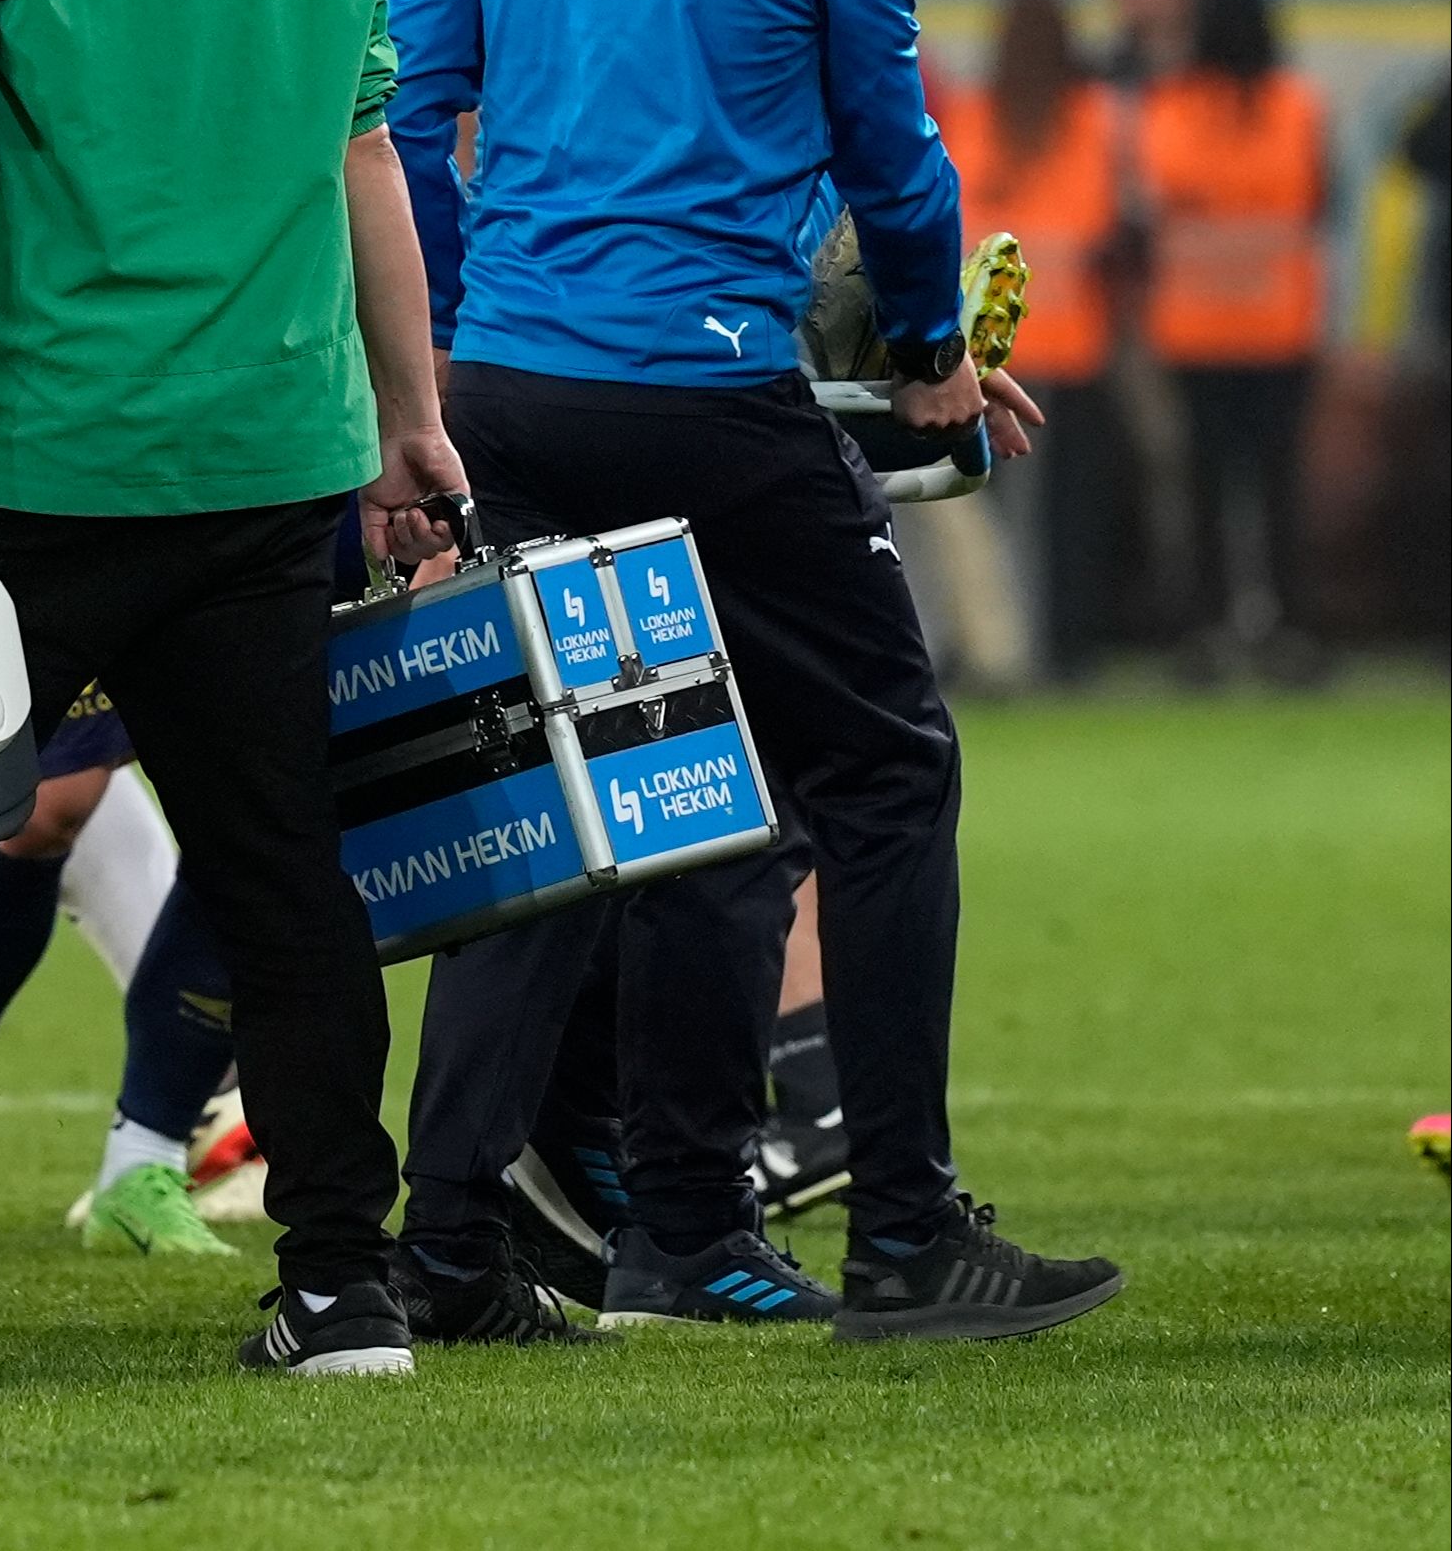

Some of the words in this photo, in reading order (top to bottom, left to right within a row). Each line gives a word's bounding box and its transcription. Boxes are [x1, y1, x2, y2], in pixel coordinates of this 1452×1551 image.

[639, 606, 697, 632] LOKMAN
[555, 627, 611, 653] LOKMAN
[639, 753, 737, 799] LOKMAN
